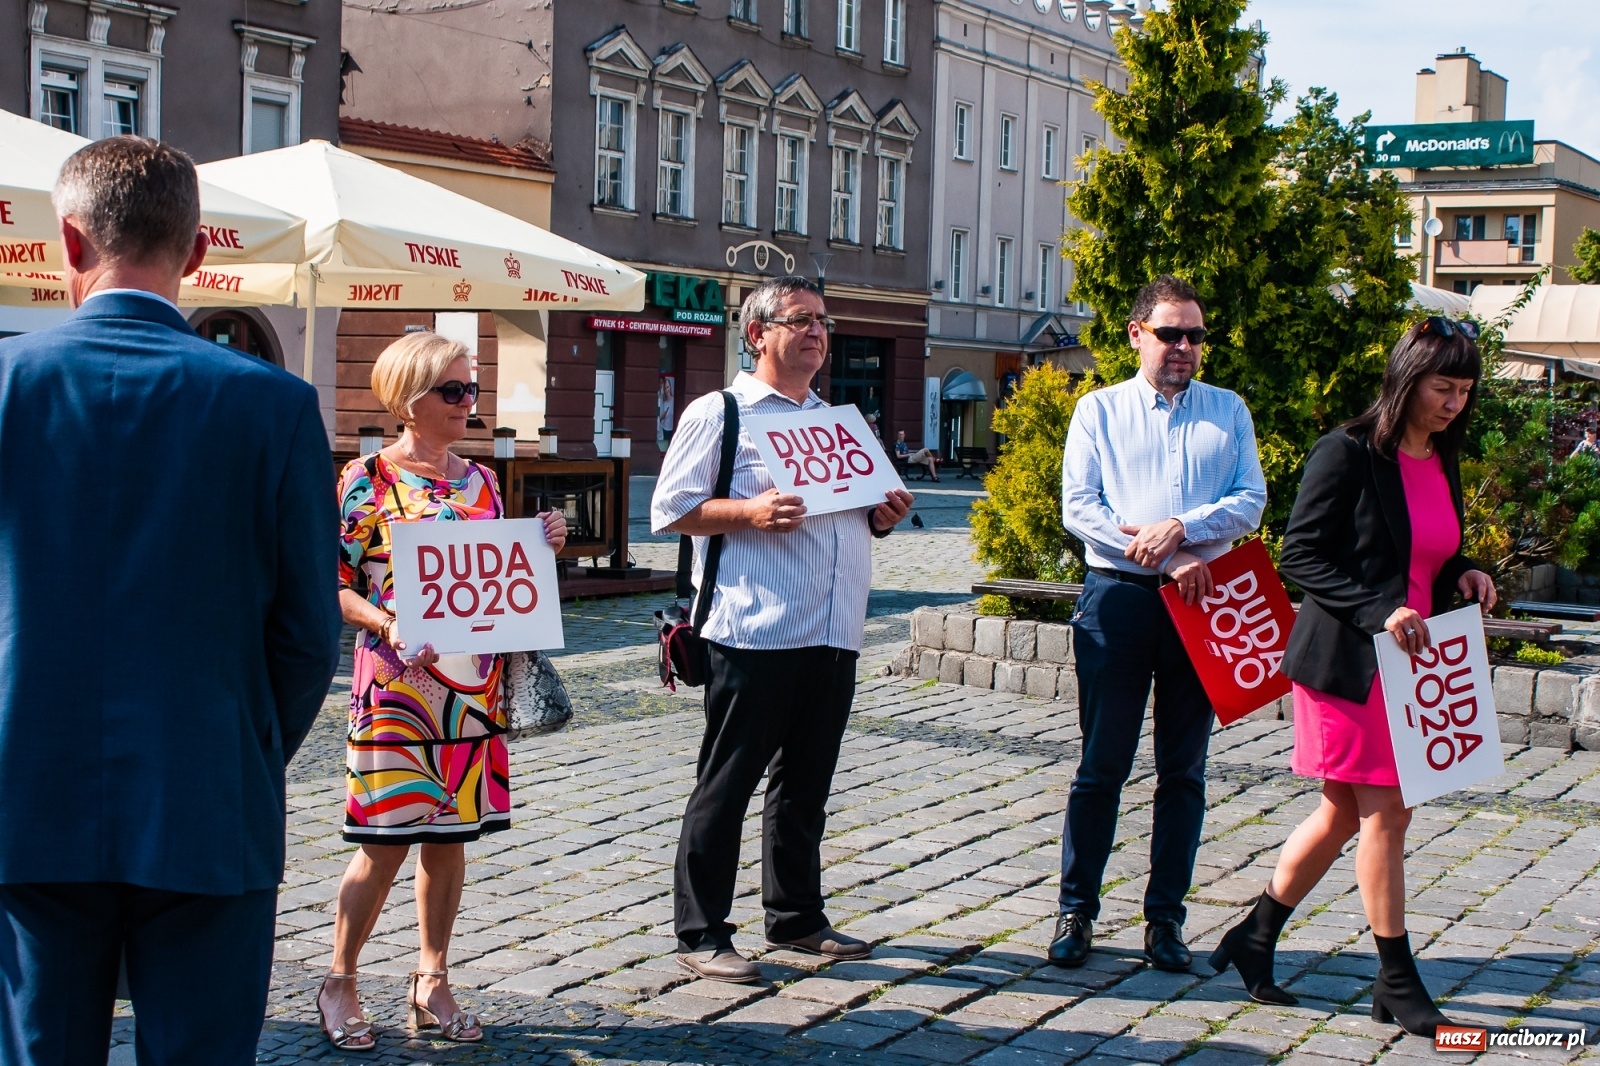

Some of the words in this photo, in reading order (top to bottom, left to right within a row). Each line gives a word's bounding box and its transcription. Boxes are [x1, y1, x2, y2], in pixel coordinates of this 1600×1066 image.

[1372, 153, 1389, 162] 00
[1390, 154, 1401, 162] m
[1405, 137, 1490, 152] McDonald's
[404, 242, 462, 268] TYSKIE
[560, 269, 610, 296] TYSKIE
[647, 272, 724, 311] EKA
[593, 318, 616, 328] RYNEK
[617, 320, 625, 329] 12
[629, 322, 659, 332] CENTRUM
[659, 323, 712, 336] FARMACEUTYCZNE
[676, 311, 692, 320] POD
[694, 311, 723, 323] RÓŻAMI
[766, 422, 862, 459] DUDA
[784, 449, 874, 487] 2020
[417, 541, 534, 582] DUDA
[421, 577, 538, 620] 2020
[1200, 584, 1266, 690] 2020
[1226, 569, 1285, 679] DUDA
[1409, 646, 1456, 771] 2020
[1438, 634, 1484, 763] DUDA
